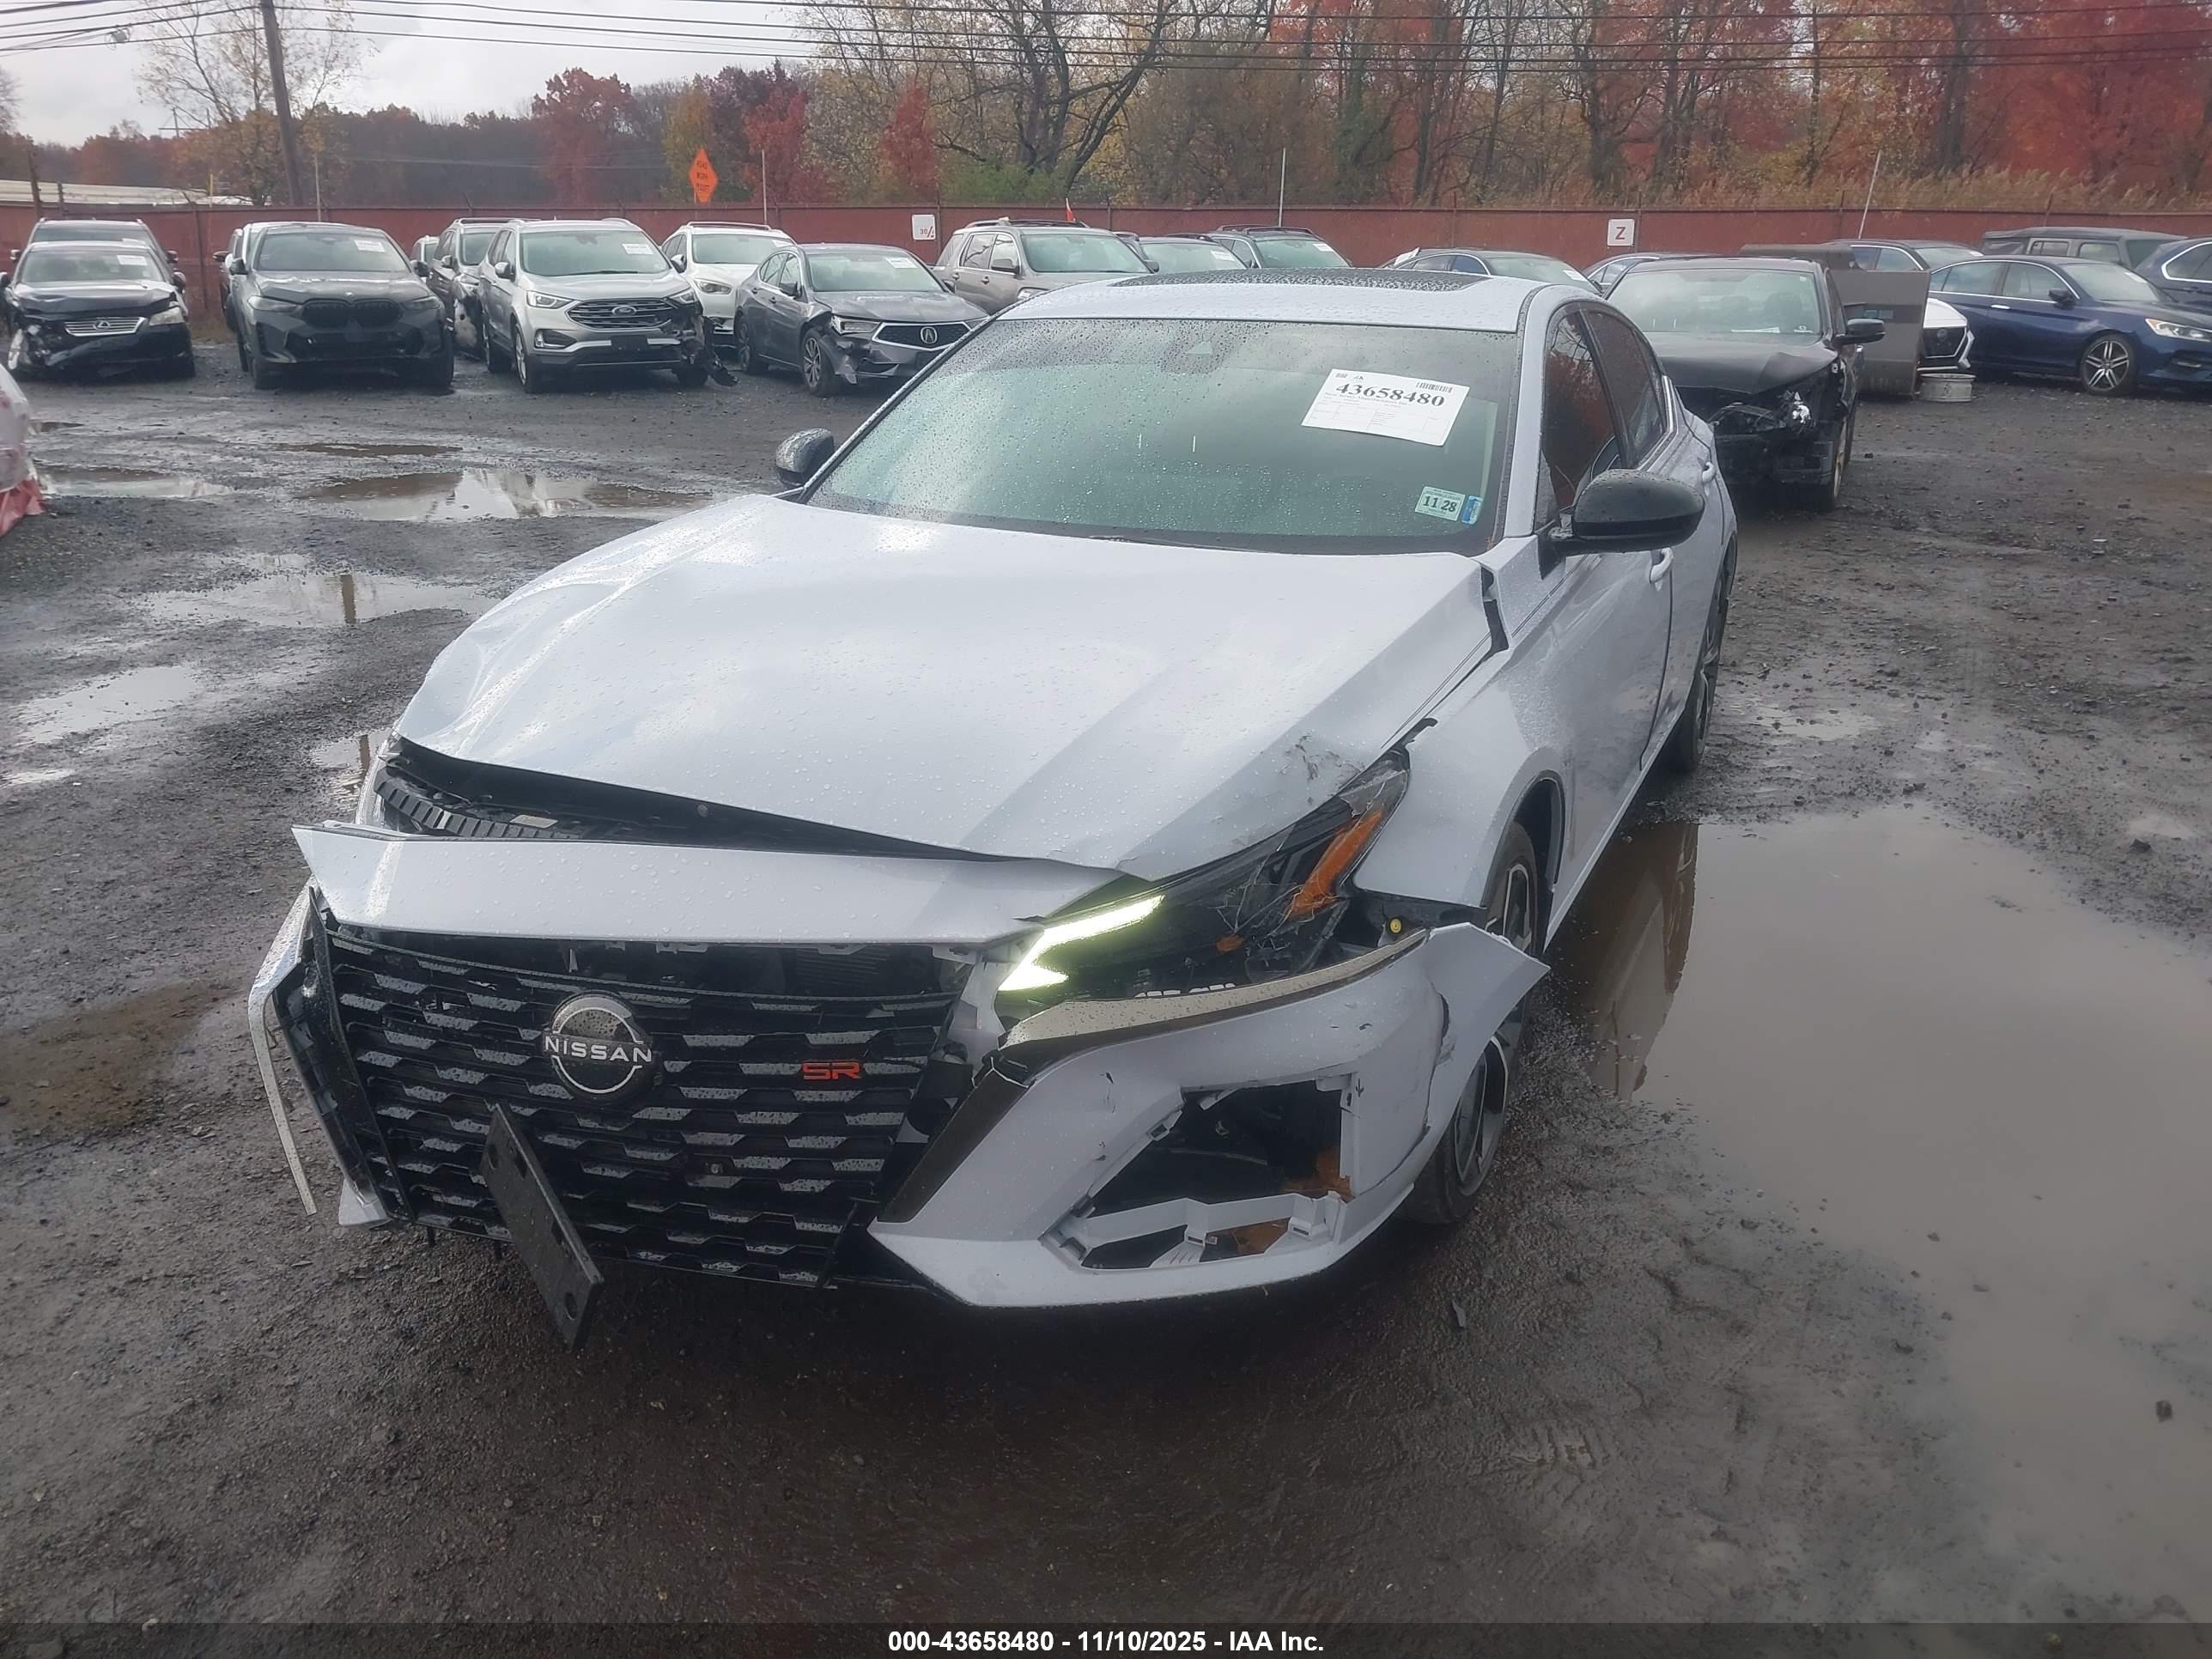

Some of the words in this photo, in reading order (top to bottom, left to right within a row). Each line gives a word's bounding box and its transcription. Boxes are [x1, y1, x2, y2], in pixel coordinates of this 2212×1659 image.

[1615, 226, 1626, 240] Z
[1336, 383, 1445, 407] 43658480
[1423, 495, 1438, 508] 11
[544, 1036, 652, 1062] NISSAN
[803, 1061, 861, 1080] SR
